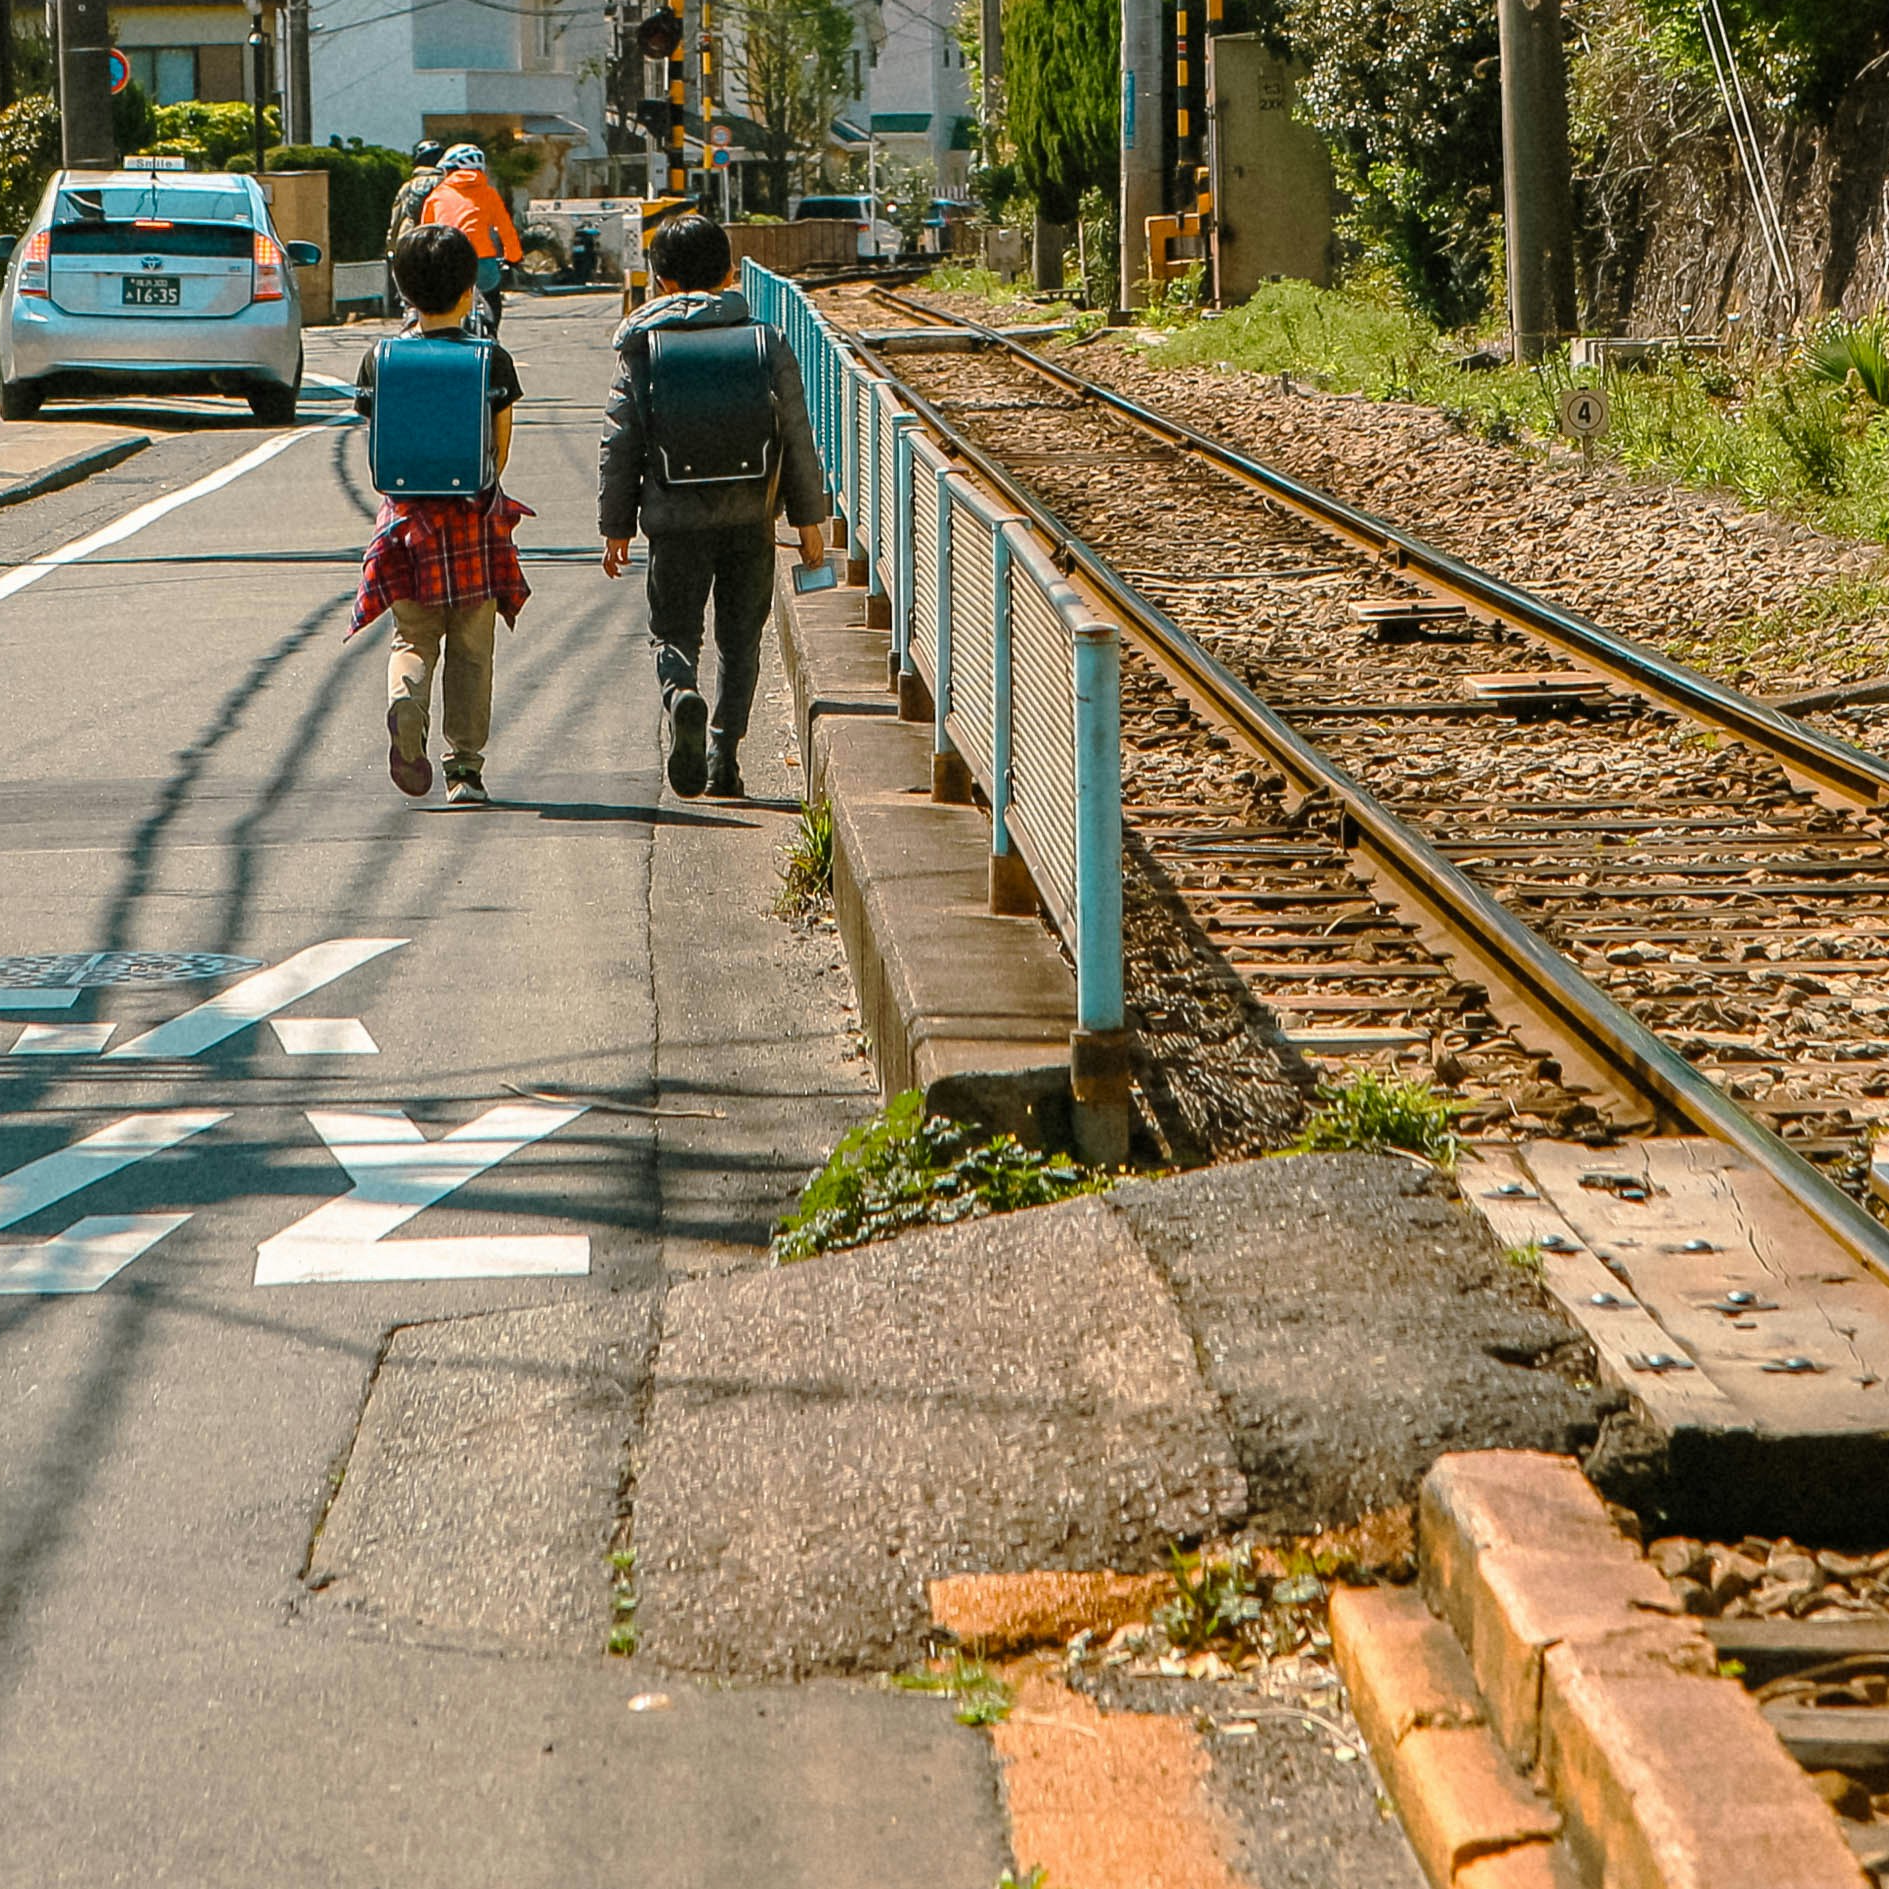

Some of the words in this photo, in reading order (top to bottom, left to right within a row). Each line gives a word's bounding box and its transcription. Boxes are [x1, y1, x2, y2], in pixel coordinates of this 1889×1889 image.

[136, 159, 173, 168] Smile
[136, 287, 178, 304] 16-35
[1578, 401, 1592, 424] 4
